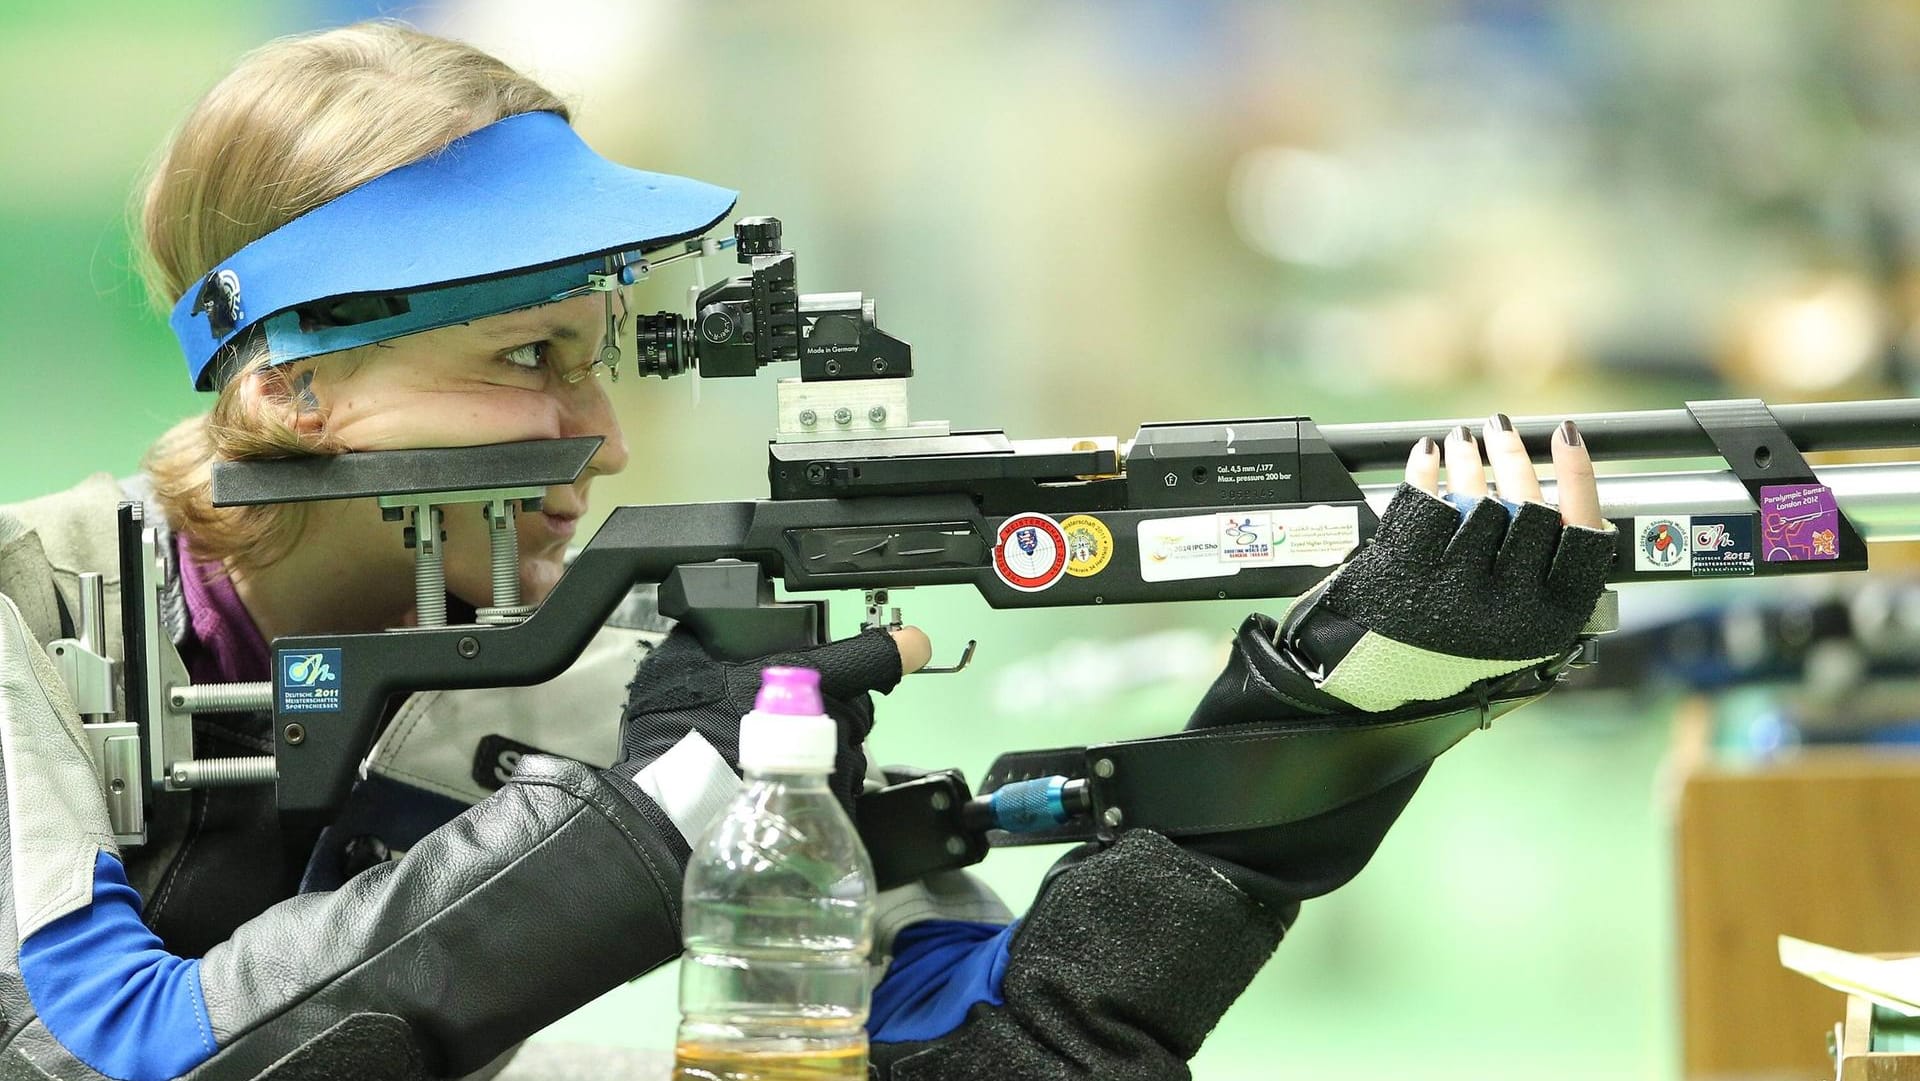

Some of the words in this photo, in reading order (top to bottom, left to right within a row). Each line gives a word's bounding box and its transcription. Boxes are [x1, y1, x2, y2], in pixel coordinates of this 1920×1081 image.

[1236, 475, 1265, 483] pressure
[1764, 490, 1802, 504] Paralympic
[1803, 486, 1825, 496] Games
[1776, 500, 1801, 510] London
[1803, 496, 1818, 504] 2012
[315, 688, 338, 697] 2011
